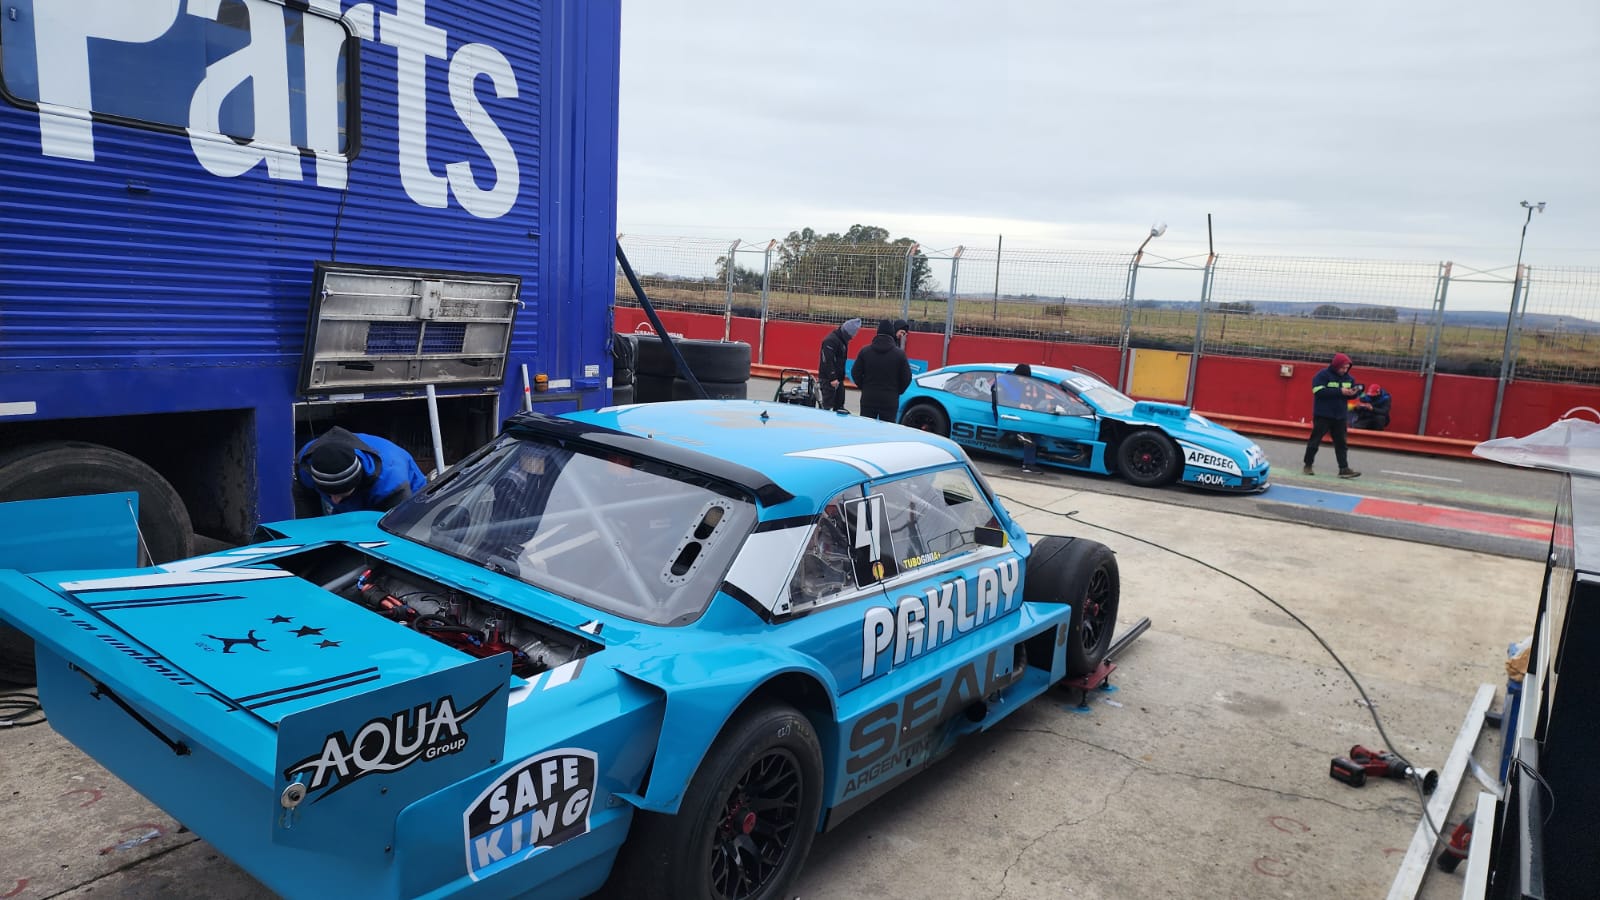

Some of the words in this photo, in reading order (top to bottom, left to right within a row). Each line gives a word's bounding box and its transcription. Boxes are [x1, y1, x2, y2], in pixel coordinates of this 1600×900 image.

[33, 0, 520, 219] Parts
[1188, 451, 1234, 470] APERSEG
[1197, 473, 1225, 485] AQUA
[855, 497, 882, 563] 4
[861, 557, 1019, 681] PAKLAY
[300, 698, 470, 789] AQUA
[426, 737, 466, 759] Group
[842, 733, 936, 799] ARGENTIN
[489, 757, 579, 825] SAFE
[475, 788, 590, 868] KING
